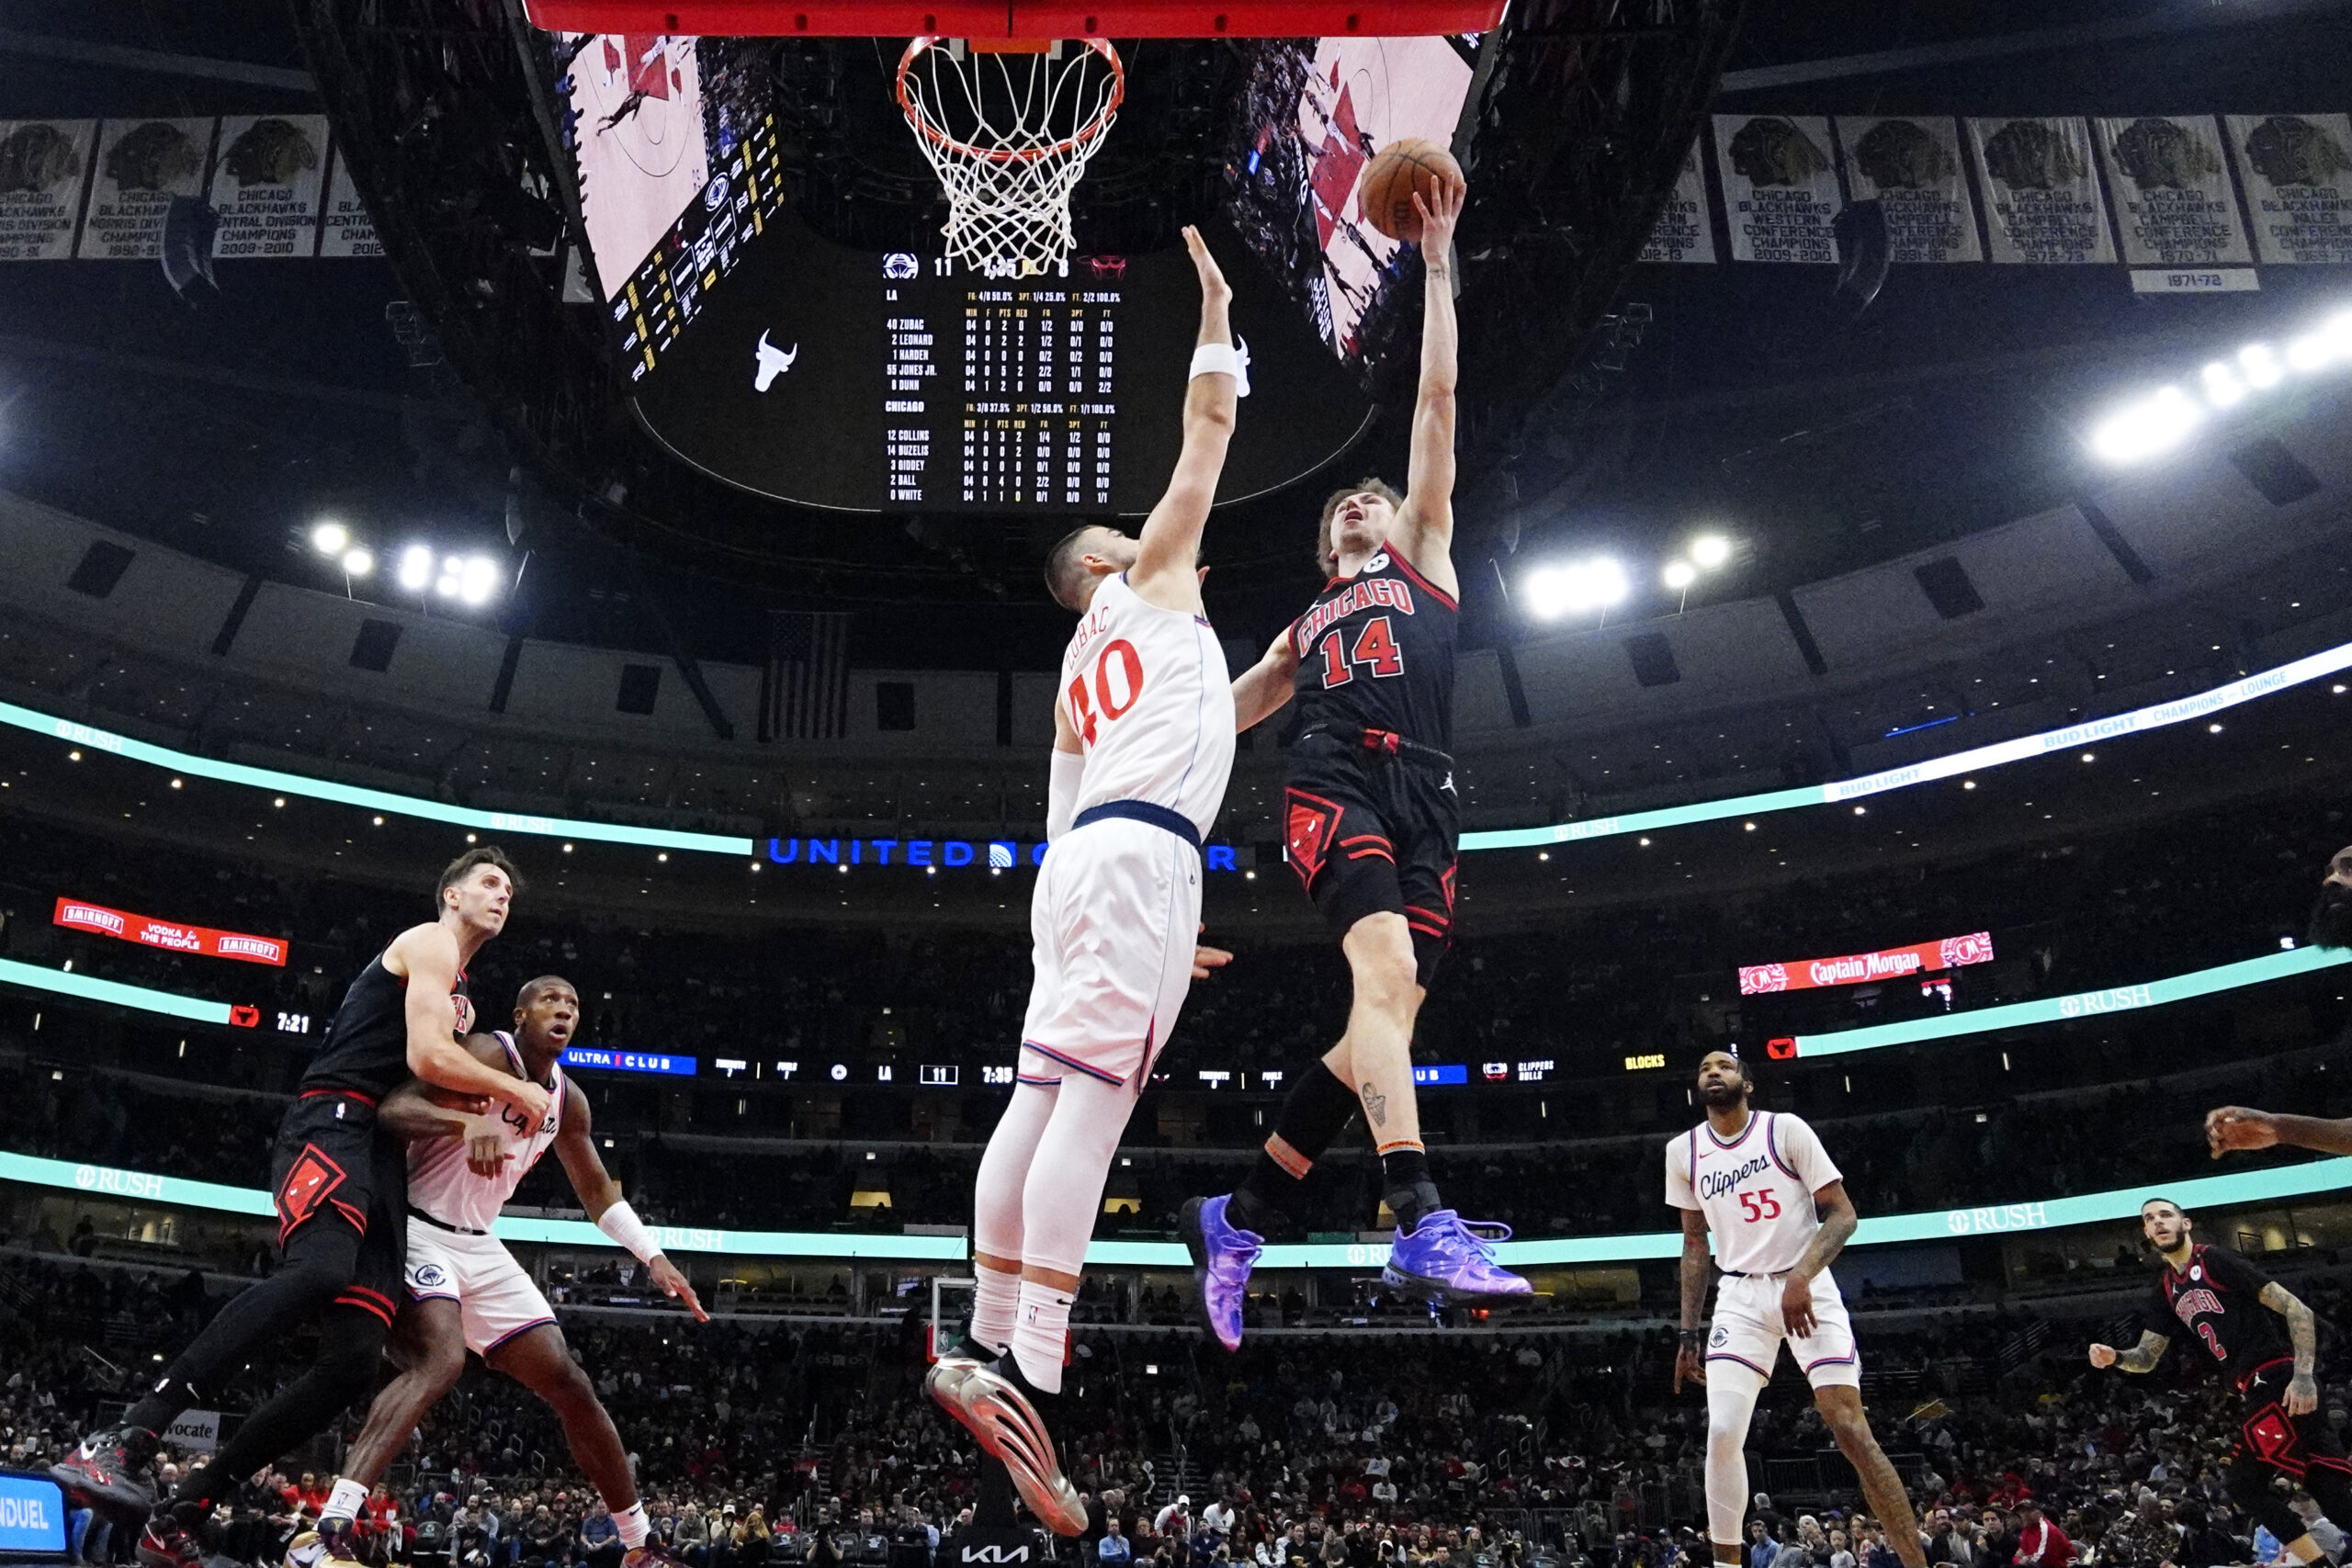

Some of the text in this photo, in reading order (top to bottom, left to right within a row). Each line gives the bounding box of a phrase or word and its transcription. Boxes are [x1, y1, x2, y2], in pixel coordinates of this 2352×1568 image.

[237, 189, 293, 201] CHICAGO
[1752, 189, 1811, 202] CHICAGO
[2143, 190, 2204, 202] CHICAGO
[219, 202, 307, 214] BLACKHAWKS
[1738, 201, 1832, 214] BLACKHAWKS
[1753, 213, 1821, 225] WESTERN
[222, 228, 296, 241] CHAMPIONS
[1743, 224, 1836, 238] CONFERENCE
[220, 242, 294, 254] 2009-2010
[695, 227, 715, 274] 7:35
[1752, 237, 1831, 250] CHAMPIONS
[1753, 249, 1832, 261] 2009-2010
[935, 257, 951, 276] 11
[887, 290, 897, 300] LA
[978, 291, 990, 301] 4/8
[992, 292, 1012, 301] 50.0%
[1045, 292, 1065, 301] 25.0%
[1083, 292, 1094, 303] 2/2
[1097, 293, 1120, 302] 100.0%
[887, 319, 923, 330] 40 ZUBAC
[892, 334, 933, 345] 2 LEONARD
[893, 349, 928, 360] 1 HARDEN
[888, 365, 897, 375] 55
[899, 365, 923, 376] JONES
[899, 379, 919, 390] DUNN
[886, 401, 924, 412] CHICAGO
[990, 403, 1010, 412] 37.5%
[1043, 404, 1063, 412] 50.0%
[1091, 404, 1114, 413] 100.0%
[888, 430, 929, 441] 12 COLLINS
[888, 445, 929, 456] 14 BUZELIS
[891, 460, 896, 470] 3
[890, 475, 916, 485] 2 BALL
[890, 490, 922, 501] 0 WHITE
[1297, 578, 1415, 660] CHICAGO
[1066, 606, 1109, 671] ZUBAC
[1319, 615, 1404, 690] 14
[1068, 638, 1144, 749] 40
[2153, 671, 2287, 722] CHAMPIONS LOUNGE
[73, 724, 124, 753] RUSH
[2043, 716, 2136, 748] BUD LIGHT
[1838, 769, 1921, 796] BUD LIGHT
[1570, 817, 1620, 839] RUSH
[770, 838, 974, 867] UNITED
[67, 907, 121, 931] SMIRNOFF
[148, 923, 182, 938] VODKA
[141, 931, 200, 950] THE PEOPLE
[221, 939, 277, 957] SMIRNOFF
[1810, 953, 1921, 987] Captain Morgan
[2082, 983, 2153, 1013] RUSH
[277, 1011, 310, 1033] 7:21
[568, 1051, 671, 1070] ULTRA CLUB
[1518, 1060, 1555, 1072] CLIPPERS
[1625, 1054, 1665, 1070] BLOCKS
[878, 1066, 1013, 1083] LA 11 7:35
[1416, 1069, 1440, 1082] UB
[1519, 1071, 1543, 1081] BULLS
[96, 1168, 164, 1199] RUSH
[1700, 1155, 1771, 1201] Clippers
[1738, 1188, 1781, 1224] 55
[1973, 1201, 2049, 1231] RUSH
[663, 1227, 723, 1249] RUSH
[2197, 1322, 2227, 1361] 2
[168, 1422, 213, 1439] vocate
[0, 1498, 49, 1530] NDUEL
[962, 1544, 1029, 1563] KIA
